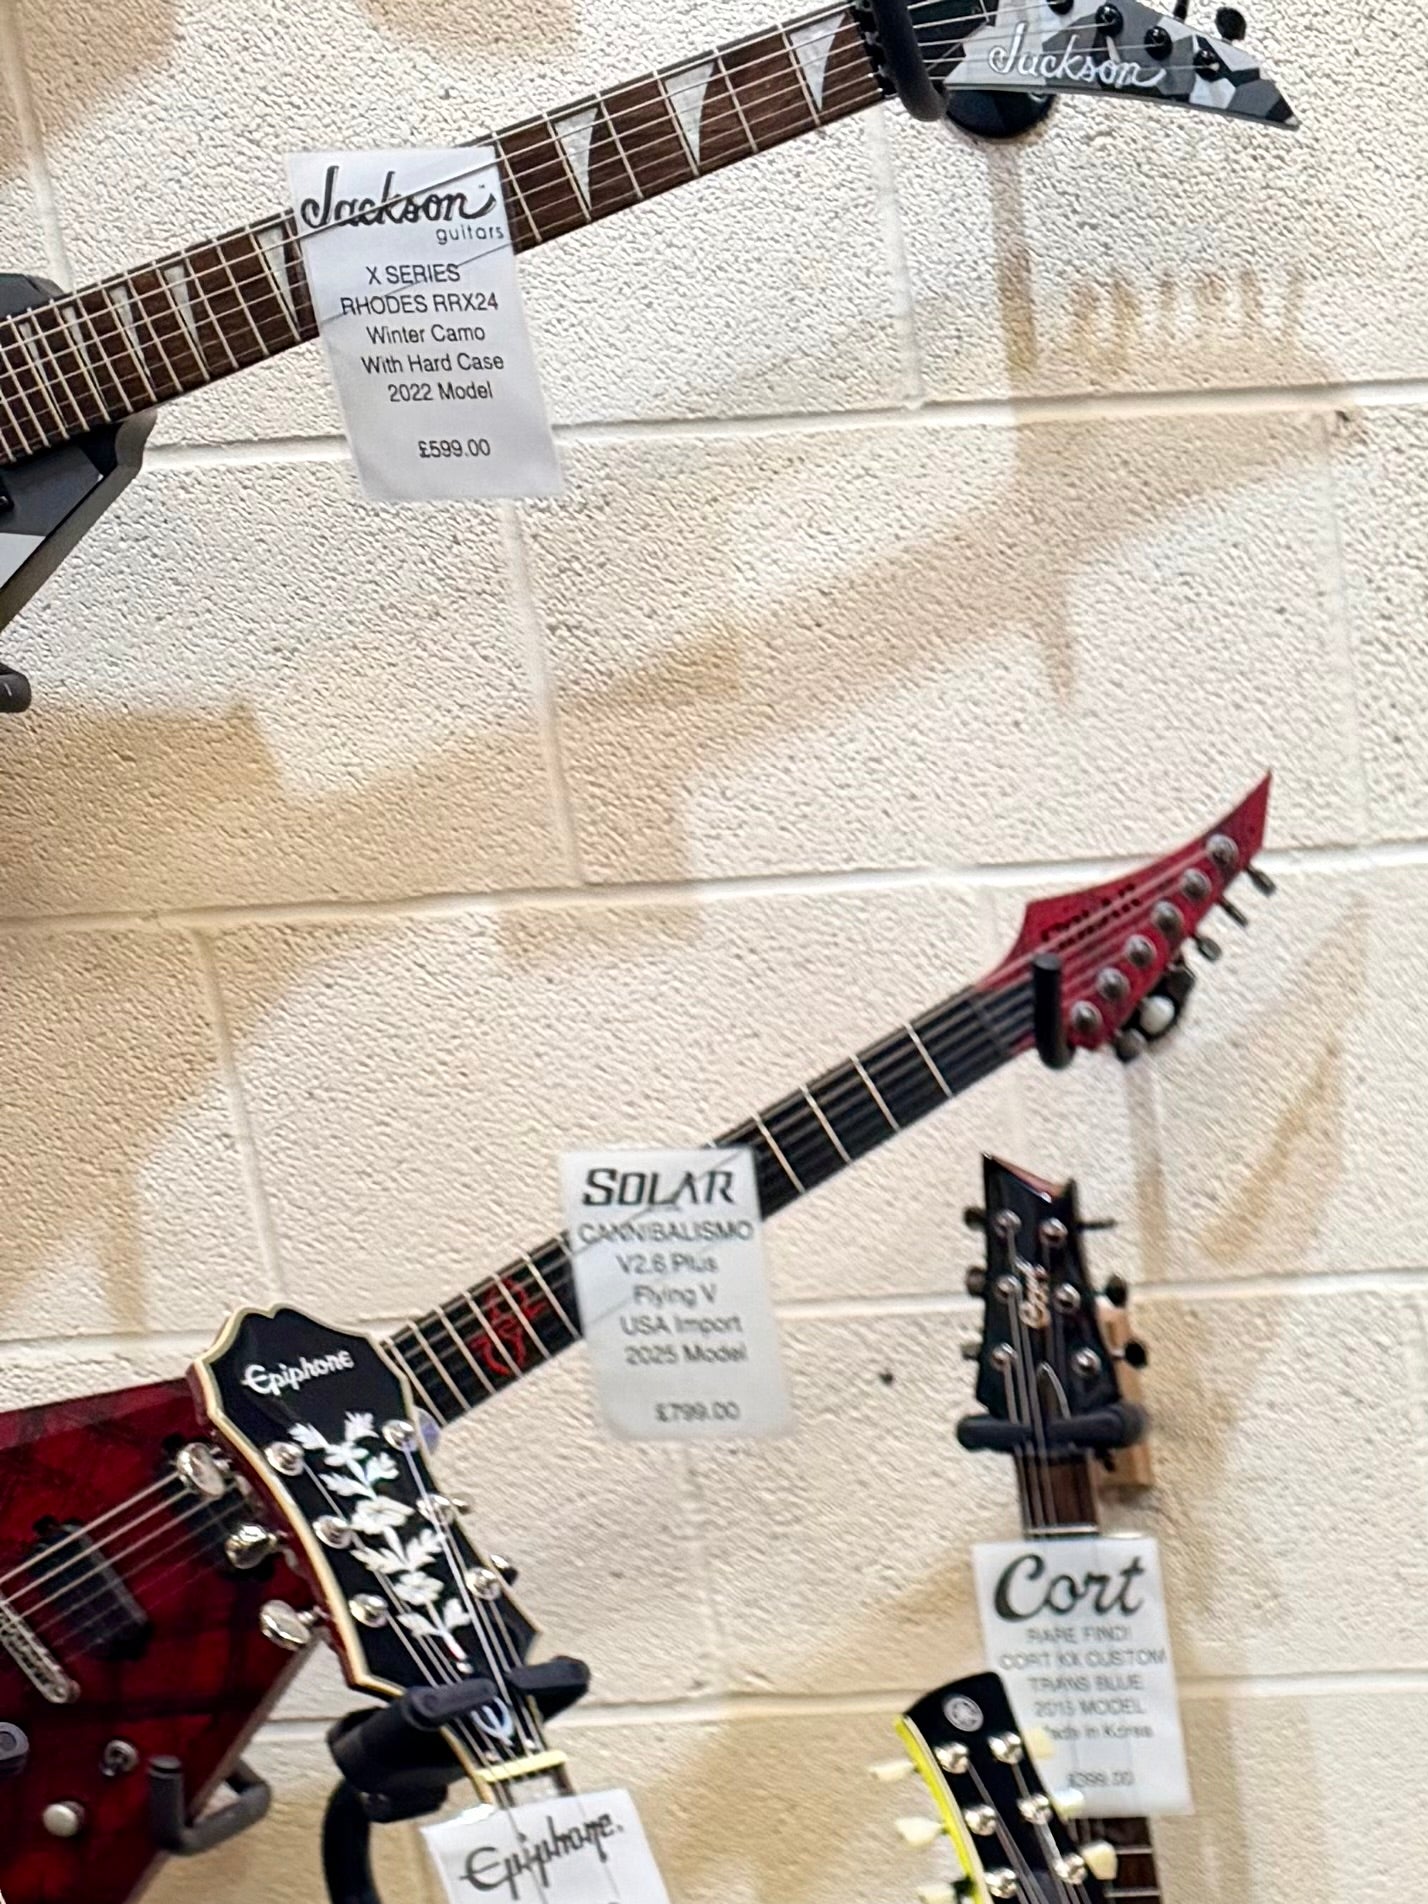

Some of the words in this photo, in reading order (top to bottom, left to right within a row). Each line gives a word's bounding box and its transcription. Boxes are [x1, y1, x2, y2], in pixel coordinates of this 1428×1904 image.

[988, 22, 1167, 88] Jackson
[301, 166, 496, 228] Jackson
[436, 224, 504, 245] guitars
[366, 265, 382, 286] X
[386, 263, 461, 284] SERIES
[340, 294, 428, 316] RHODES
[434, 291, 499, 313] RRX24
[366, 325, 425, 346] Winter
[431, 324, 486, 344] Camo
[361, 356, 402, 375] With
[409, 354, 452, 373] Hard
[457, 352, 504, 371] Case
[388, 383, 434, 403] 2022
[438, 381, 494, 401] Model
[418, 438, 491, 460] £599.00
[582, 1168, 737, 1206] SOLAR
[672, 1253, 718, 1274] Plus
[633, 1284, 697, 1308] Flying
[701, 1283, 717, 1304] V
[620, 1316, 671, 1336] USA
[675, 1315, 744, 1337] Import
[682, 1345, 748, 1364] Model
[240, 1350, 355, 1396] Epiphone
[655, 1401, 740, 1423] £799.00
[994, 1553, 1146, 1623] Cort
[460, 1813, 619, 1901] Epiphone
